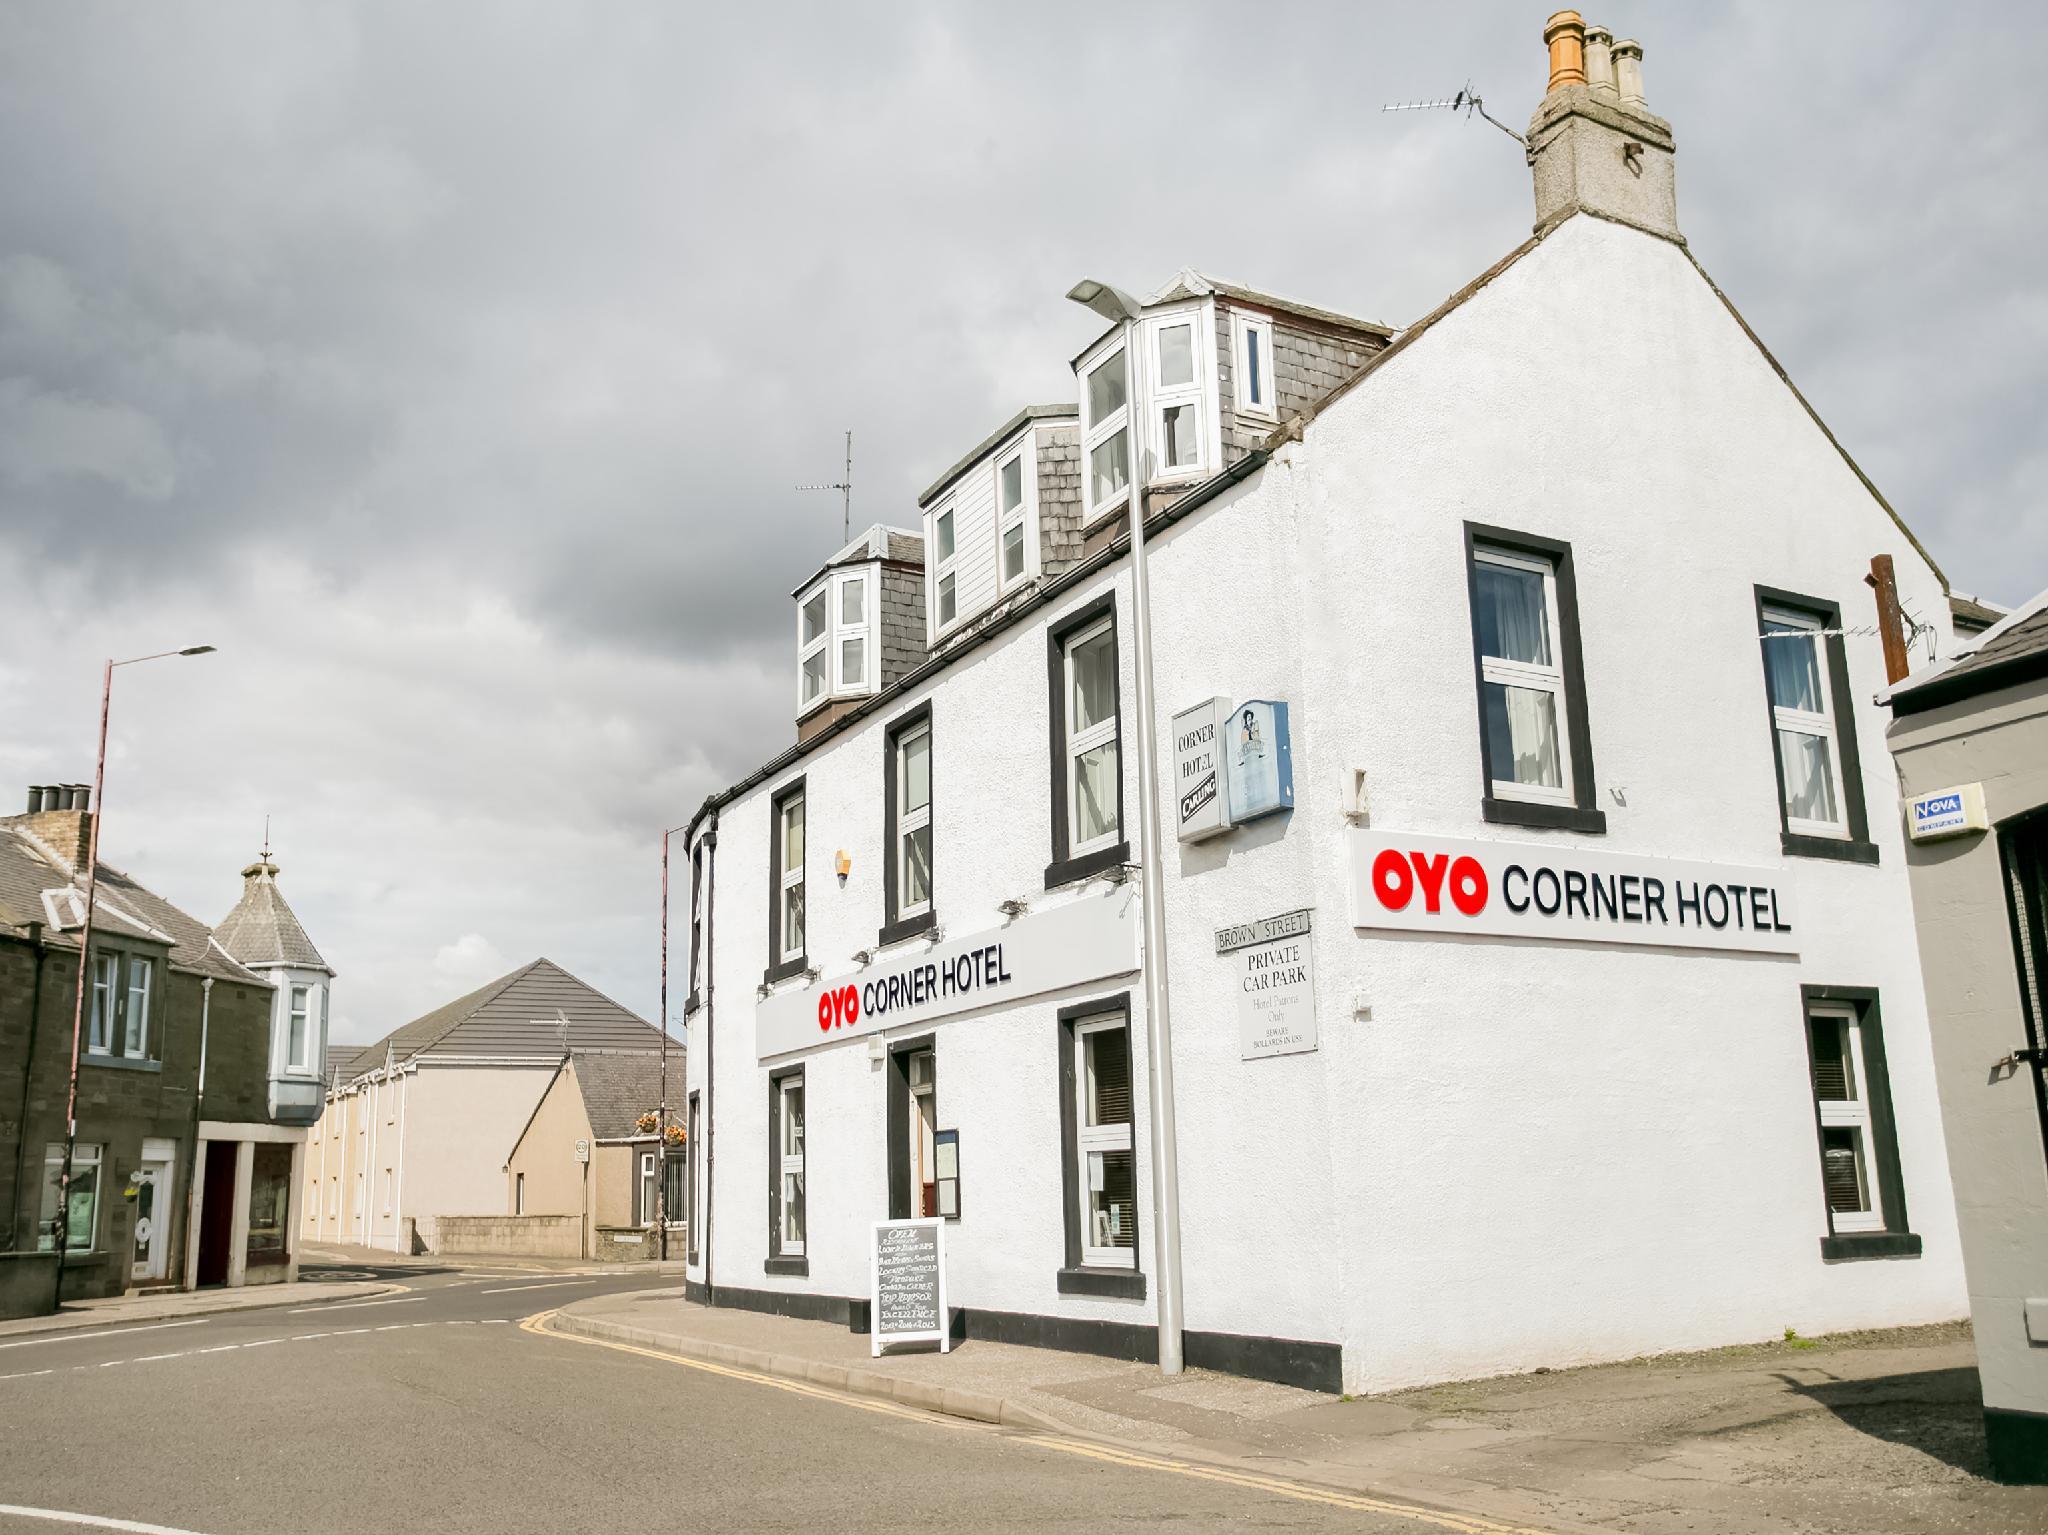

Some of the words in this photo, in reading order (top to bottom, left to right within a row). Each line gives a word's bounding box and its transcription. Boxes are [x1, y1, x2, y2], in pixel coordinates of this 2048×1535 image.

[1178, 723, 1215, 753] CORNER
[1182, 752, 1214, 778] HOTEL
[1181, 778, 1216, 818] CARLING
[1372, 849, 1489, 915] OYO
[1502, 864, 1669, 924] CORNER
[1676, 880, 1792, 932] HOTEL
[1219, 927, 1256, 947] BROWN
[1265, 914, 1304, 937] STREET
[1248, 945, 1300, 971] PRIVATE
[818, 984, 859, 1032] OYO
[863, 964, 938, 1017] CORNER
[942, 943, 1012, 997] HOTEL
[1243, 974, 1269, 992] CAR
[1273, 966, 1306, 988] PARK
[1253, 996, 1272, 1010] Hotel
